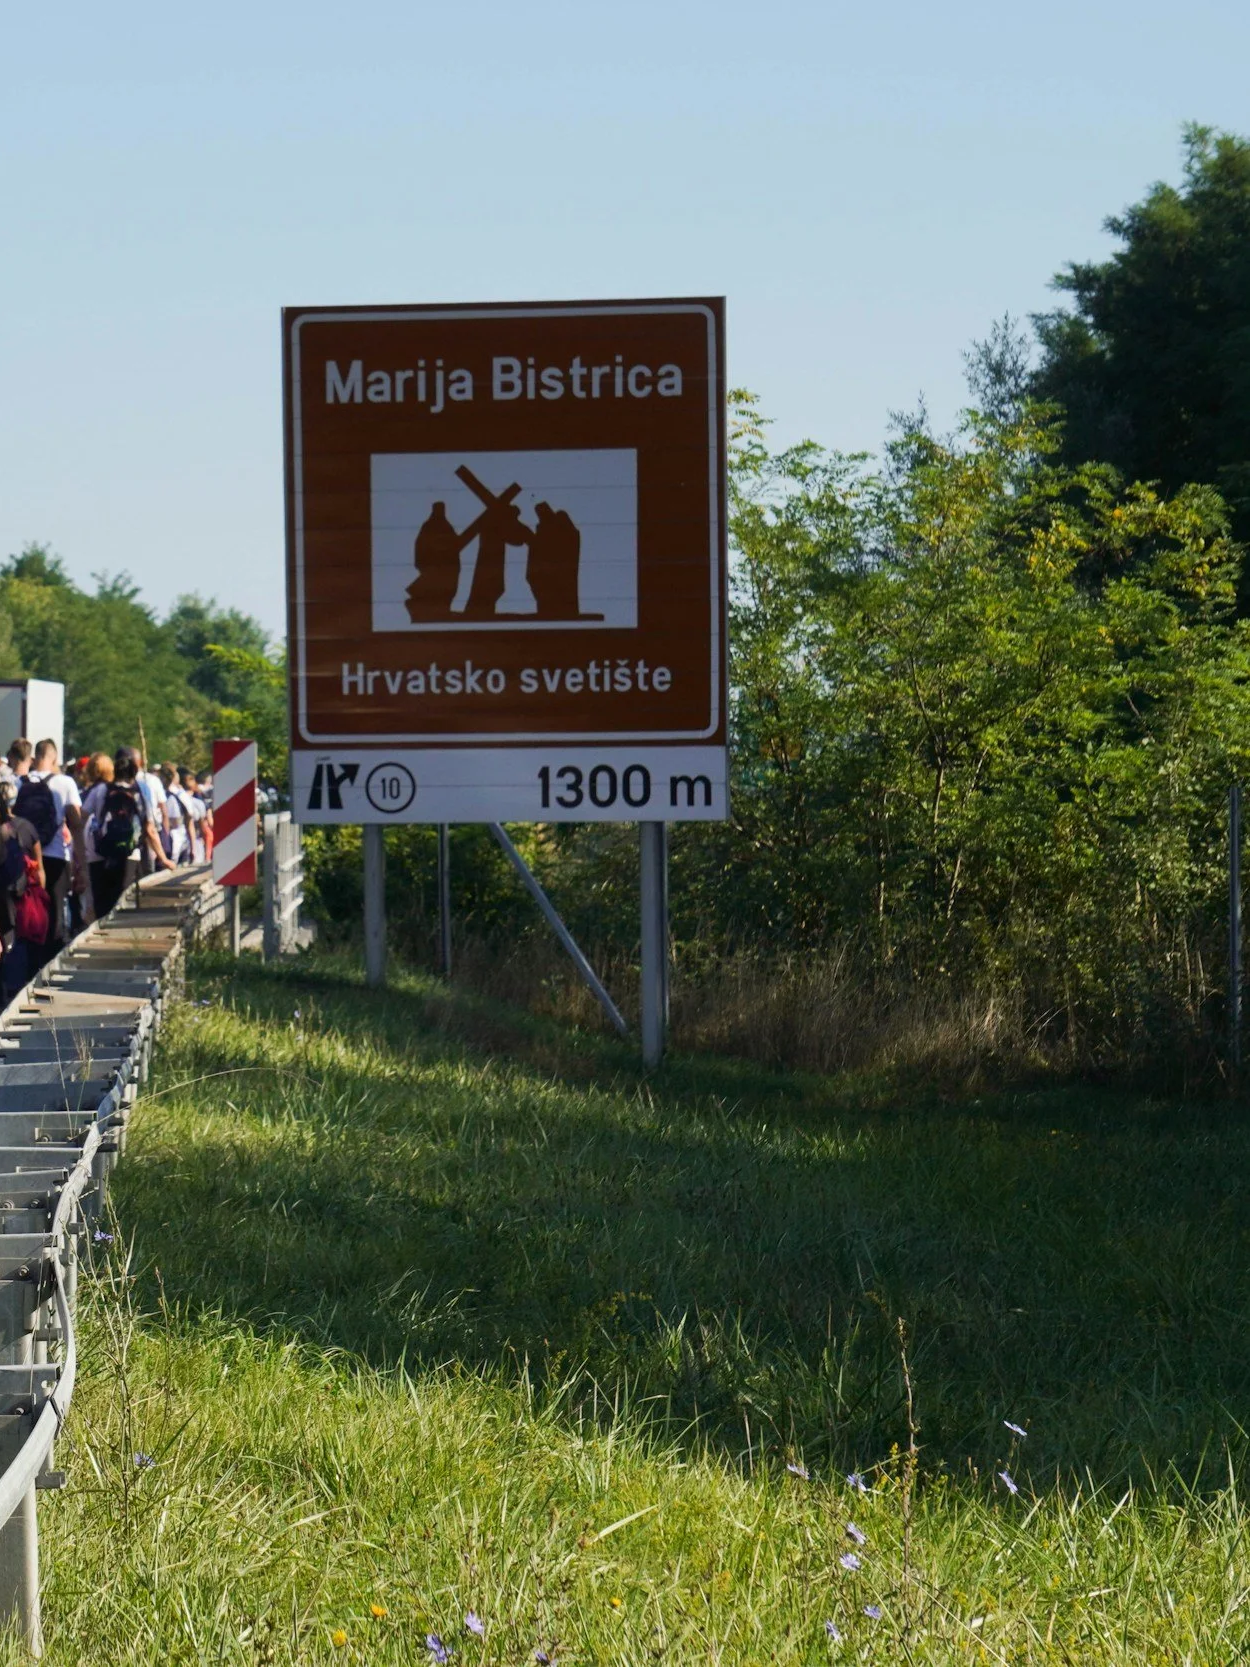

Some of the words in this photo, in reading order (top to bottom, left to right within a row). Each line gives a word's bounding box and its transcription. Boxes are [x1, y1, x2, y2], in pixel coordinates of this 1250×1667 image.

[325, 359, 473, 414] Marija
[492, 355, 683, 400] Bistrica
[342, 660, 506, 695] Hrvatsko
[519, 659, 672, 693] svetište
[381, 777, 400, 799] 10
[537, 764, 651, 808] 1300
[669, 775, 712, 806] m
